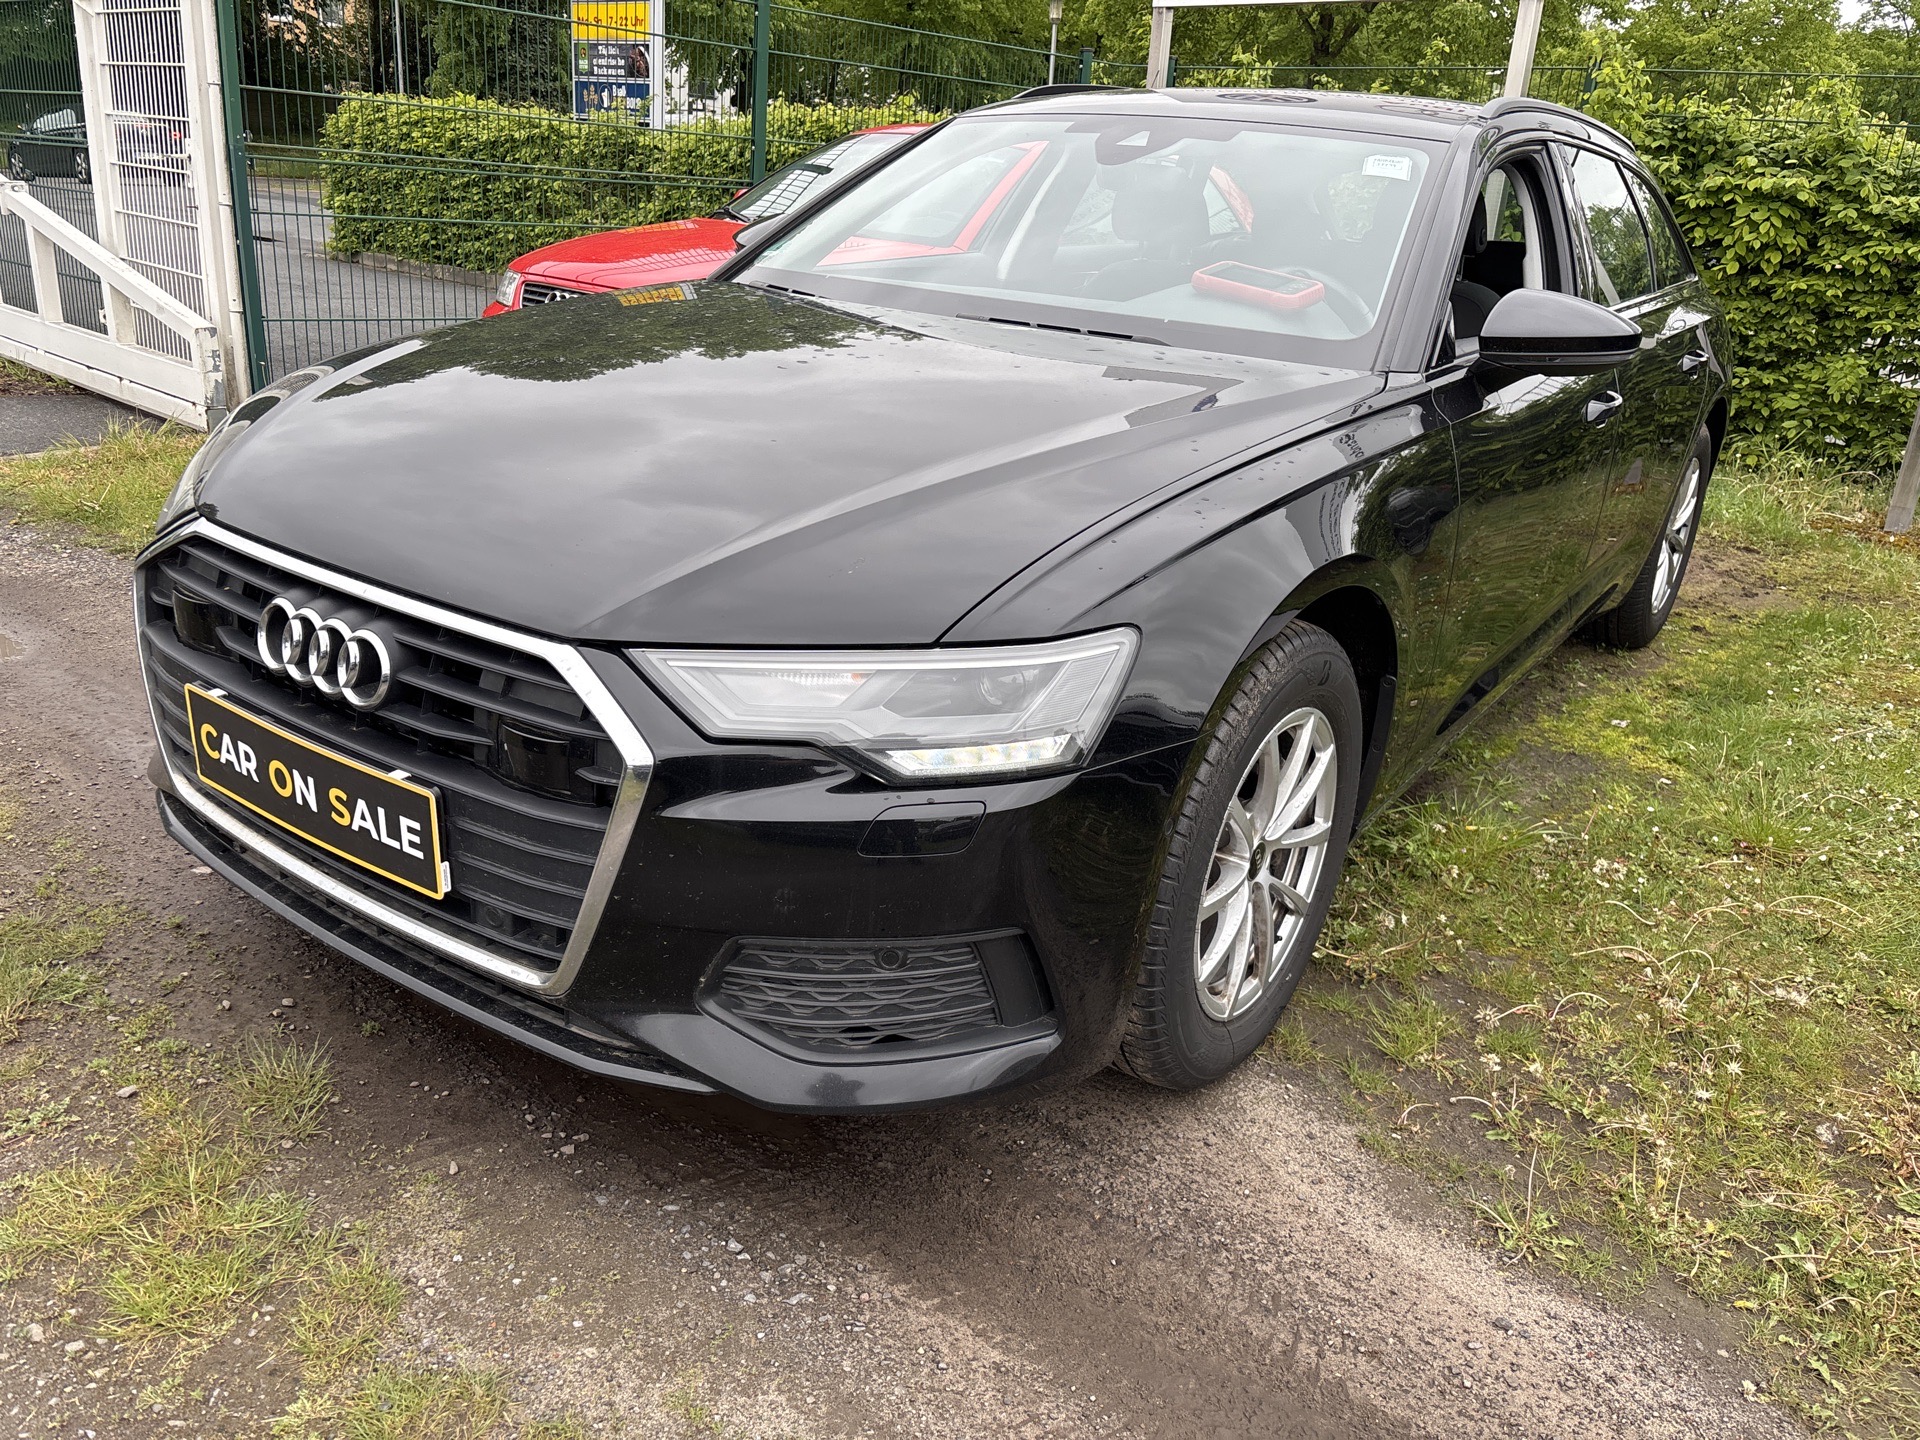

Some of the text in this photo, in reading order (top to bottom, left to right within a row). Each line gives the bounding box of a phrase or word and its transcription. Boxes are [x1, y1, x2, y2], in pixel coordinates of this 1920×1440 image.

[631, 16, 644, 26] Uhr
[200, 723, 425, 860] CAR ON SALE
